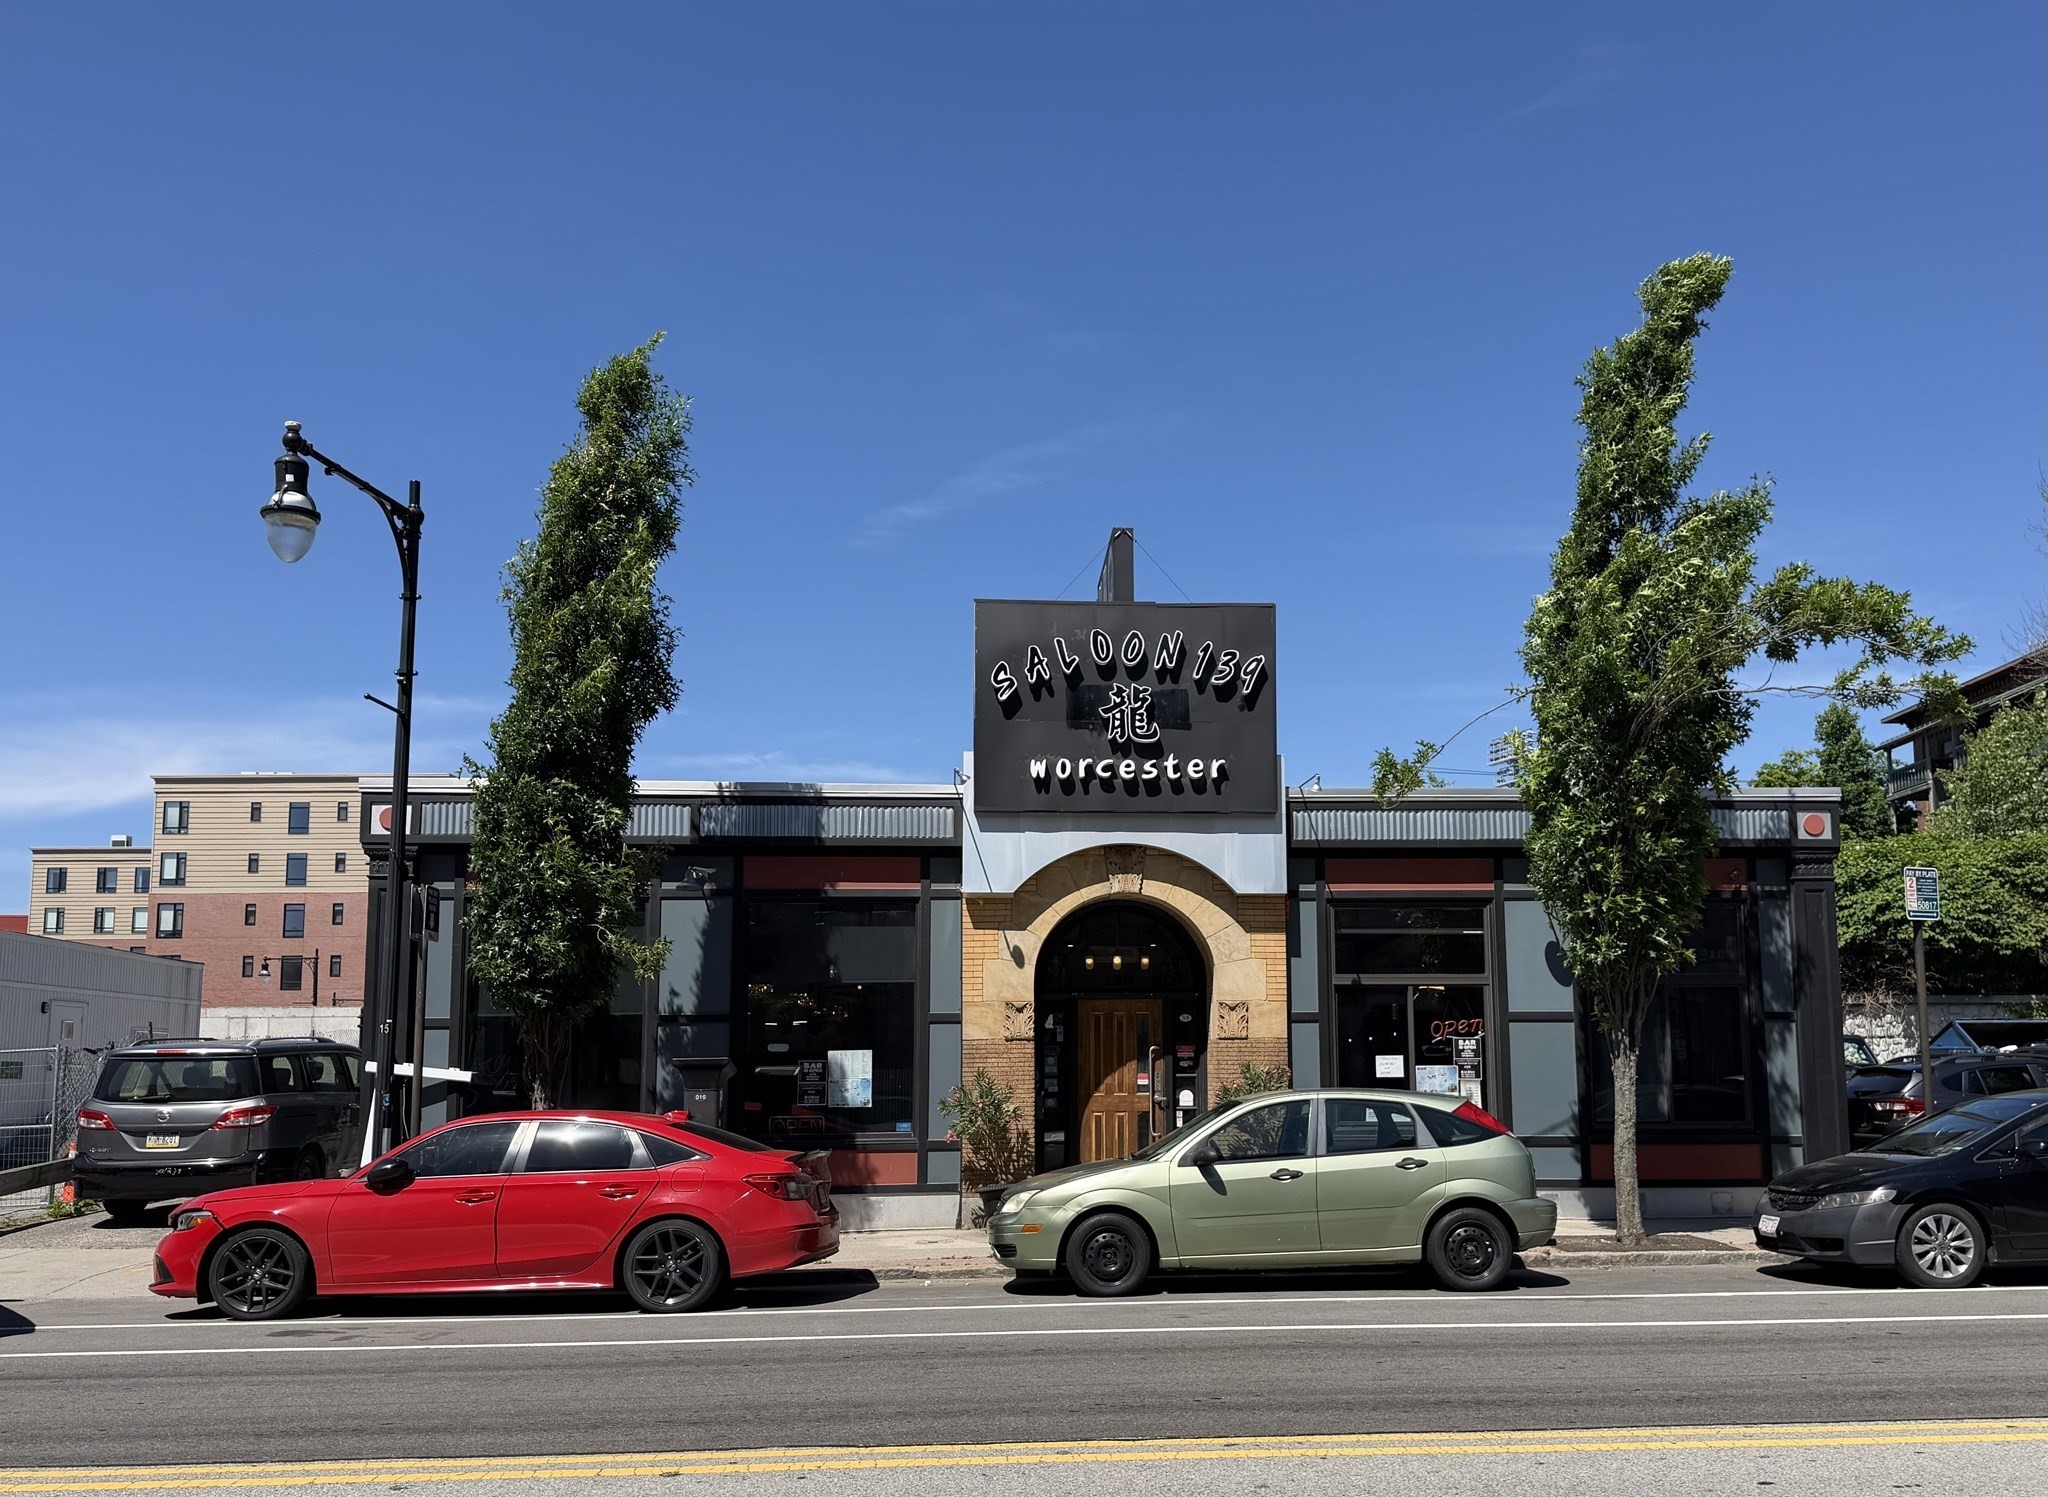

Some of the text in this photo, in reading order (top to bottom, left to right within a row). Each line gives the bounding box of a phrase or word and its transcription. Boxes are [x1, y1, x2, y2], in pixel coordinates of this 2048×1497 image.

[991, 628, 1266, 701] SALOON 139
[1099, 682, 1160, 743] 龍
[1908, 878, 1914, 889] 2
[380, 1024, 389, 1034] 15
